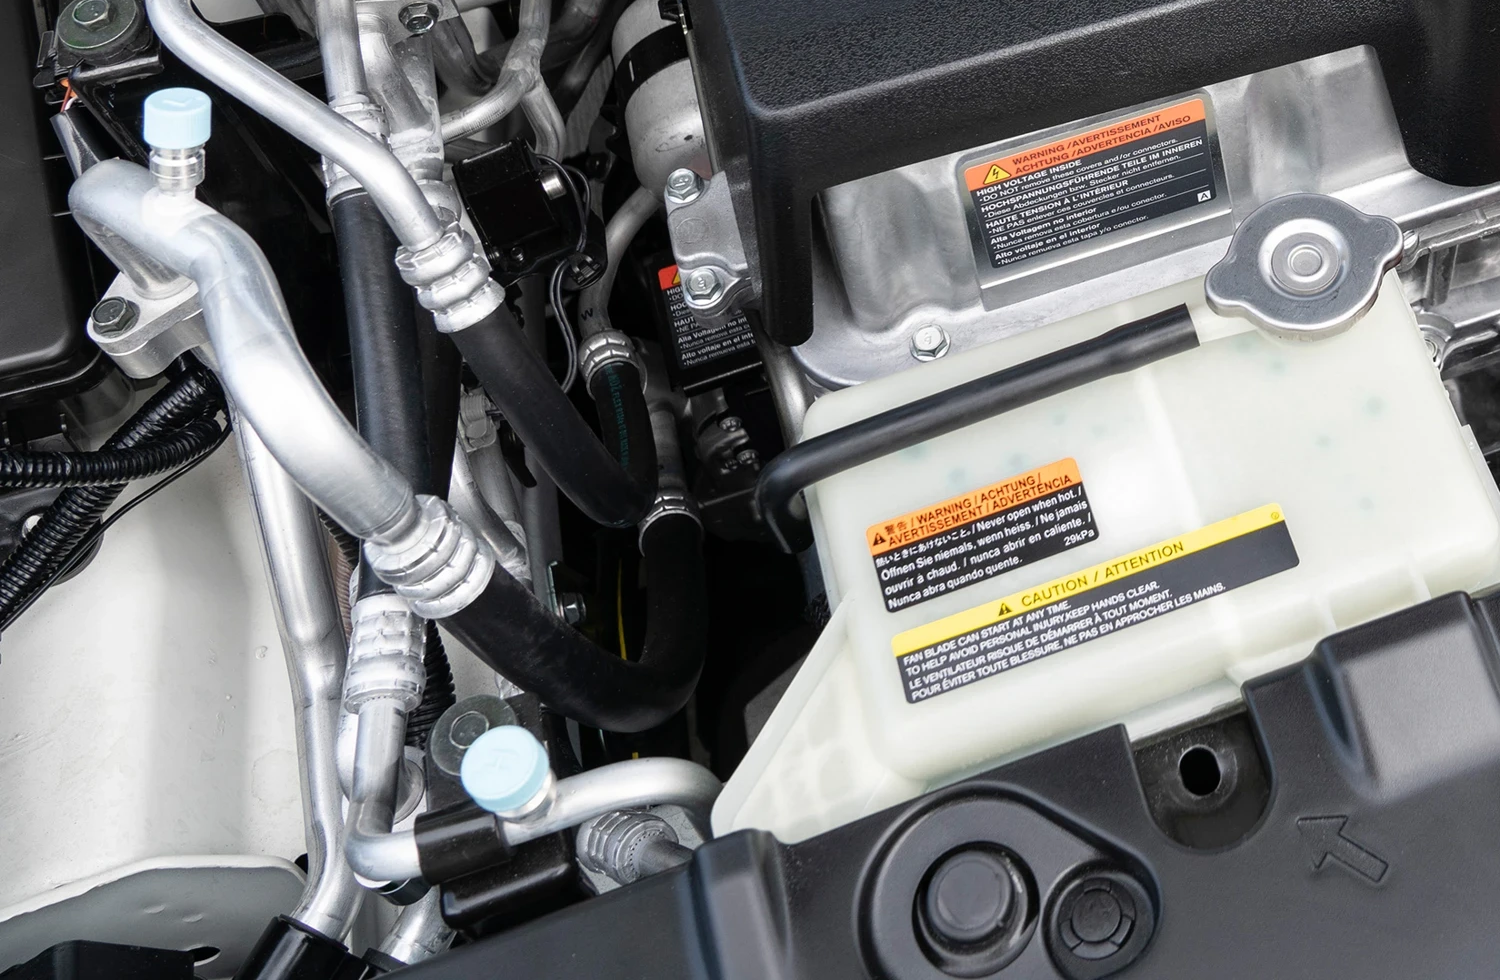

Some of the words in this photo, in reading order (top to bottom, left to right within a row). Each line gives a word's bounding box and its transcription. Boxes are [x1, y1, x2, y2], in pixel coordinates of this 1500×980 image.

[976, 183, 1001, 196] HIGH
[1003, 169, 1047, 188] VOLTAGE
[1049, 159, 1081, 174] INSIDE
[980, 164, 1119, 212] HOCHSPANNUNGSFÜHRENDE
[1121, 156, 1146, 169] TEILE
[1148, 152, 1158, 160] IM
[1161, 138, 1202, 156] INNEREN
[998, 185, 1018, 197] NOT
[1020, 176, 1050, 190] remove
[1052, 168, 1074, 181] these
[1075, 160, 1102, 174] covers
[1132, 137, 1178, 157] connectors.
[1012, 143, 1064, 165] WARNING
[1013, 151, 1069, 174] ACHTUNG
[1005, 218, 1025, 229] PAS
[1026, 209, 1054, 223] enlever
[1056, 204, 1071, 214] ces
[1073, 191, 1113, 209] couvercles
[1115, 188, 1124, 196] et
[1126, 172, 1174, 193] connecteurs.
[1013, 188, 1067, 210] Abdeckungen
[1069, 182, 1087, 193] bzw.
[1089, 172, 1119, 187] Stecker
[1121, 165, 1140, 177] nicht
[1142, 153, 1180, 170] entfernen.
[1200, 192, 1210, 201] A
[985, 213, 1018, 228] HAUTE
[1019, 200, 1060, 218] TENSION
[1062, 195, 1070, 205] À
[989, 234, 1007, 244] Alta
[1009, 220, 1051, 239] Voltagem
[1052, 216, 1064, 225] no
[1065, 206, 1097, 221] interior
[1024, 227, 1052, 240] remova
[1053, 221, 1071, 231] esta
[1072, 209, 1109, 226] cobertura
[1131, 191, 1167, 207] conector.
[1028, 241, 1060, 256] remueva
[1062, 235, 1079, 246] esta
[1080, 230, 1097, 240] tapa
[1113, 214, 1148, 230] conector.
[994, 249, 1013, 260] Alto
[1014, 239, 1045, 254] voltaje
[1047, 235, 1057, 243] en
[1058, 232, 1067, 240] el
[1069, 222, 1100, 237] interior
[887, 505, 983, 547] AVERTISSEMENT
[916, 497, 971, 524] WARNING
[980, 475, 1035, 502] ACHTUNG
[976, 513, 1008, 531] Never
[1007, 505, 1032, 523] open
[1031, 495, 1058, 512] when
[1057, 488, 1077, 503] hot.
[883, 575, 914, 595] ouvrir
[925, 559, 961, 581] chaud.
[969, 546, 1001, 565] nunca
[1001, 536, 1026, 554] abrir
[1027, 531, 1041, 544] en
[1042, 515, 1085, 538] caliente.
[915, 553, 933, 568] Sie
[933, 538, 976, 563] niemals,
[976, 528, 1004, 547] wenn
[1004, 518, 1034, 537] heiss.
[1039, 511, 1055, 525] Ne
[1054, 499, 1088, 520] jamais
[887, 588, 922, 609] Nunca
[922, 580, 946, 597] abra
[948, 566, 985, 590] quando
[984, 554, 1024, 577] quente.
[1062, 527, 1095, 546] 29kPa
[1020, 574, 1088, 608] CAUTION
[1103, 541, 1184, 579] ATTENTION
[902, 651, 923, 666] FAN
[923, 639, 957, 659] BLADE
[957, 631, 980, 647] CAN
[979, 620, 1012, 639] START
[1011, 615, 1024, 628] AT
[1024, 608, 1045, 623] ANY
[1045, 599, 1072, 616] TIME.
[905, 663, 921, 677] TO
[921, 654, 948, 671] HELP
[947, 643, 979, 662] AVOID
[979, 624, 1032, 651] PERSONAL
[1090, 592, 1126, 611] HANDS
[1125, 580, 1160, 599] CLEAR.
[908, 676, 922, 689] LE
[922, 654, 986, 684] VENTILATEUR
[986, 640, 1024, 662] RISQUE
[1024, 635, 1040, 648] DE
[1039, 614, 1093, 643] DÉMARRER
[1102, 604, 1128, 621] TOUT
[1128, 588, 1173, 612] MOMENT.
[911, 682, 941, 701] POUR
[941, 668, 976, 690] ÉVITER
[976, 658, 1009, 678] TOUTE
[1008, 639, 1063, 666] BLESSURE,
[1063, 633, 1078, 647] NE
[1078, 626, 1099, 642] PAS
[1098, 621, 1114, 634] EN
[1113, 600, 1174, 629] APPROCHER
[1173, 593, 1193, 608] LES
[1192, 581, 1226, 601] MAINS.
